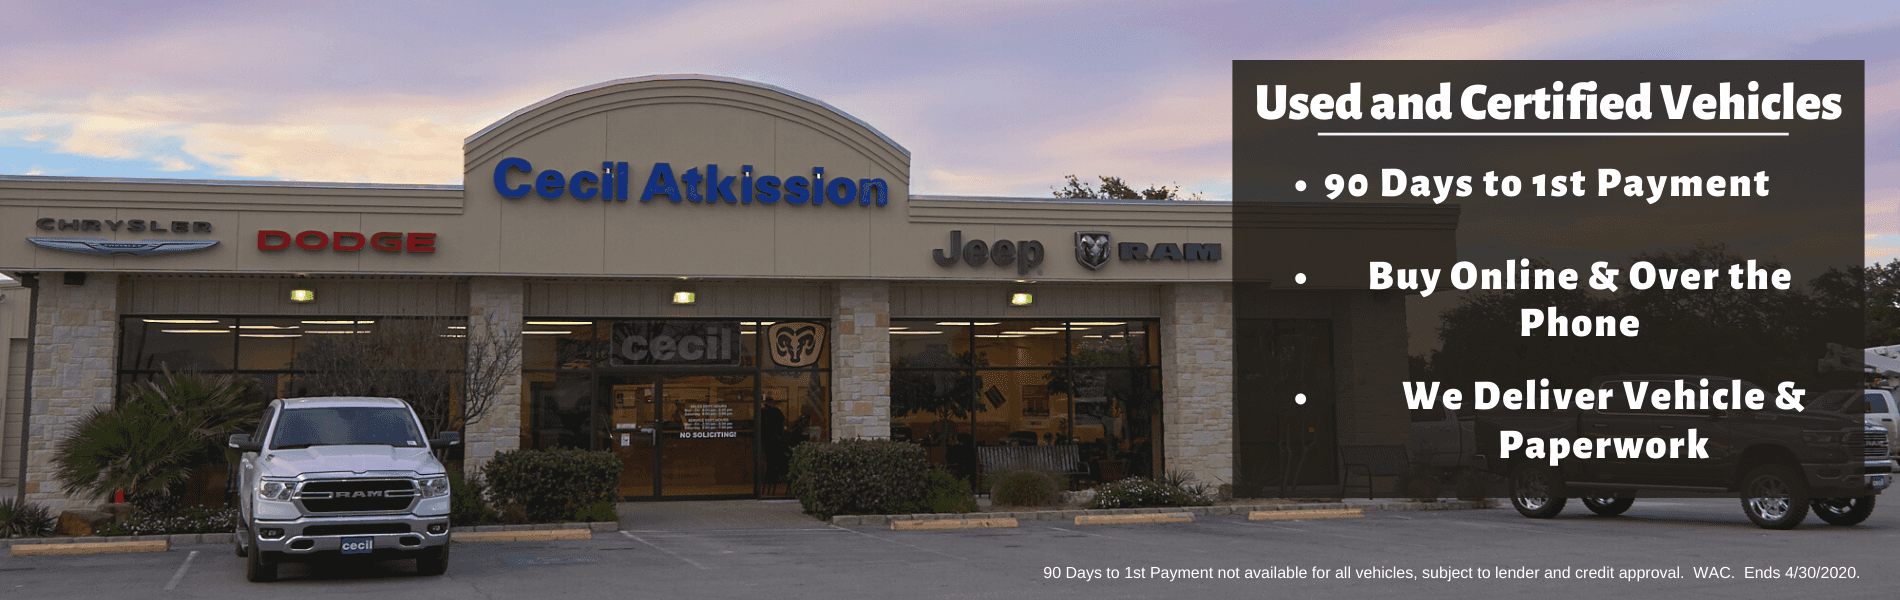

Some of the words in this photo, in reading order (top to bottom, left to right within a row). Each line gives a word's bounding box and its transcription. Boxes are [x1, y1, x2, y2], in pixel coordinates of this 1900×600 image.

[493, 156, 629, 201] Cecil
[640, 161, 889, 206] Atkission
[35, 217, 214, 233] CHRYSLER
[257, 230, 437, 253] DODGE
[1118, 241, 1222, 261] RAM
[932, 230, 1045, 275] Jeep
[621, 325, 732, 361] cecil
[679, 431, 691, 439] NO
[692, 431, 737, 439] SOLICITING!
[335, 490, 383, 498] RAM
[341, 539, 373, 551] cecil
